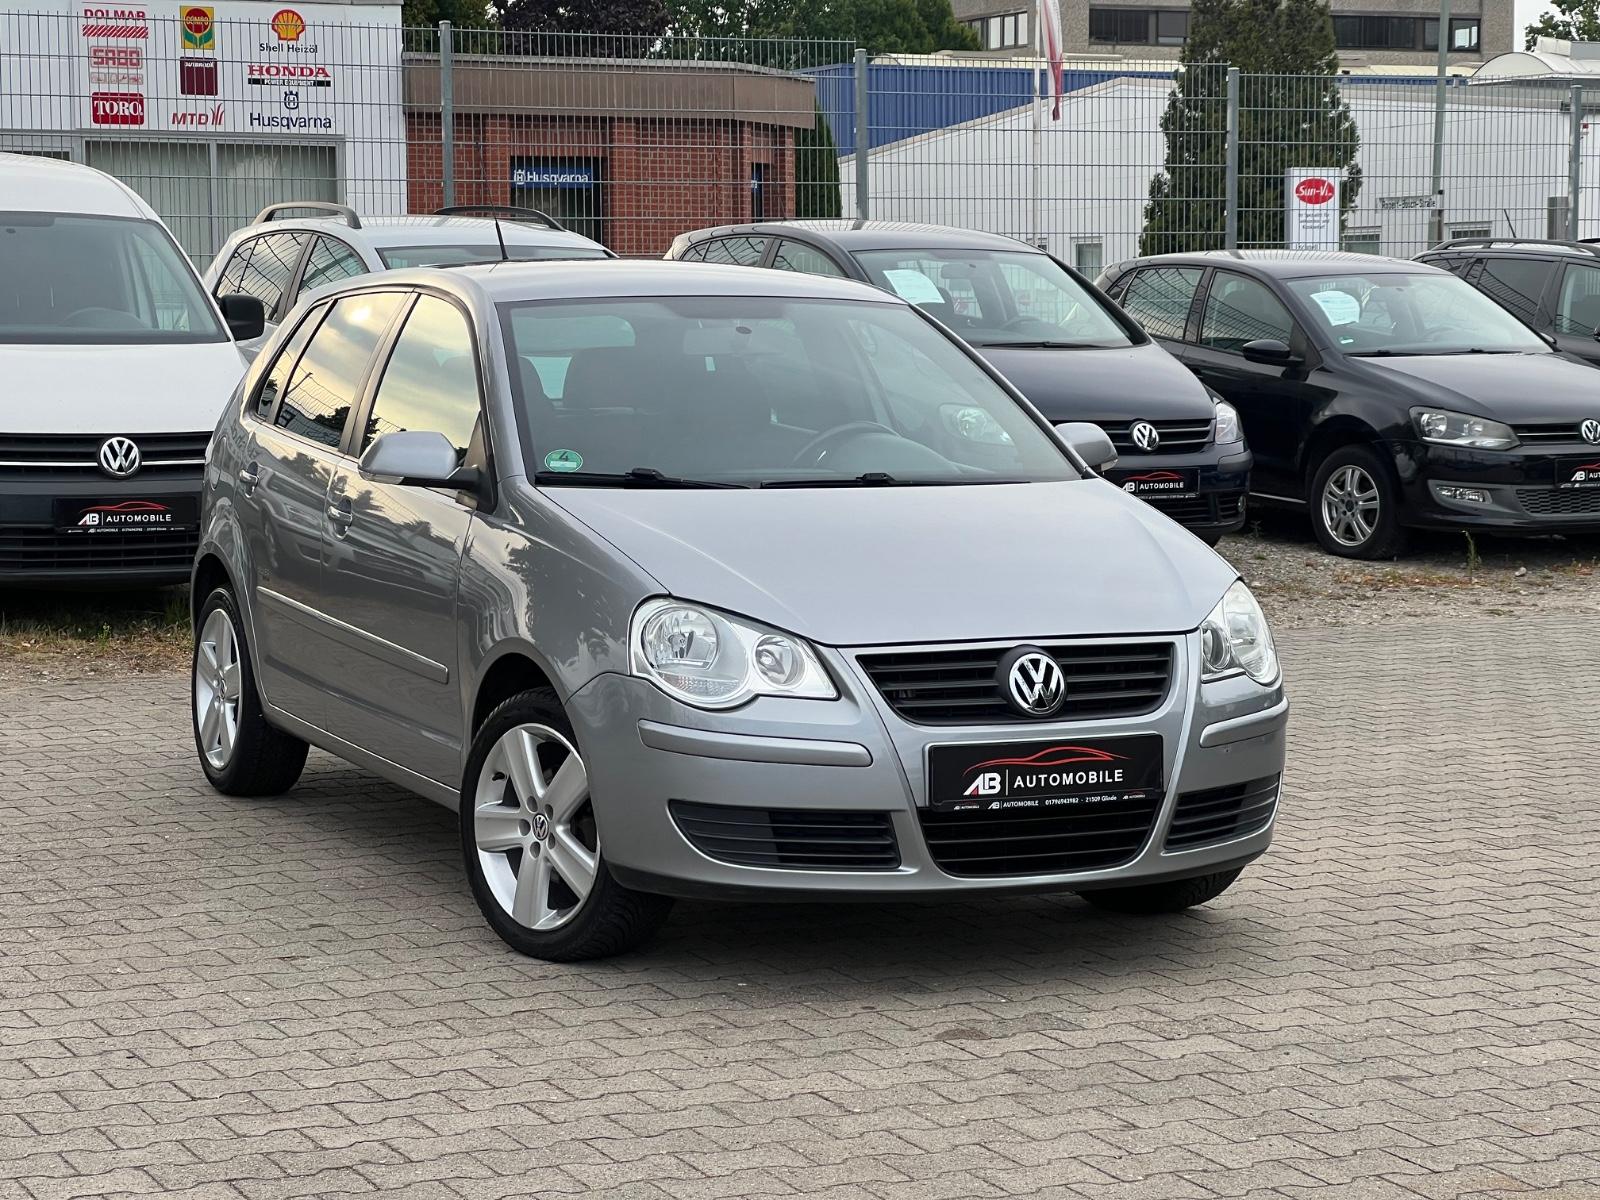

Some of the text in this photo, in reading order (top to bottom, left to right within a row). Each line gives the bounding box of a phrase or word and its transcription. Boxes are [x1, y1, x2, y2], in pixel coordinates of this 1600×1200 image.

[84, 9, 146, 20] DOLMAR
[260, 43, 318, 54] Shell Heizöl
[248, 64, 331, 78] HONDA
[94, 100, 143, 116] TORO
[171, 112, 209, 125] MTD
[249, 112, 332, 130] Husqvarna
[527, 171, 589, 186] Husqvarna
[100, 437, 139, 475] VW
[559, 451, 569, 461] 4
[1140, 482, 1184, 490] AUTOMOBILE
[106, 514, 172, 523] AUTOMOBILE
[1009, 653, 1065, 714] VW
[963, 769, 1124, 796] AB AUTOMOBILE
[1003, 800, 1039, 808] AUTOMOBILE
